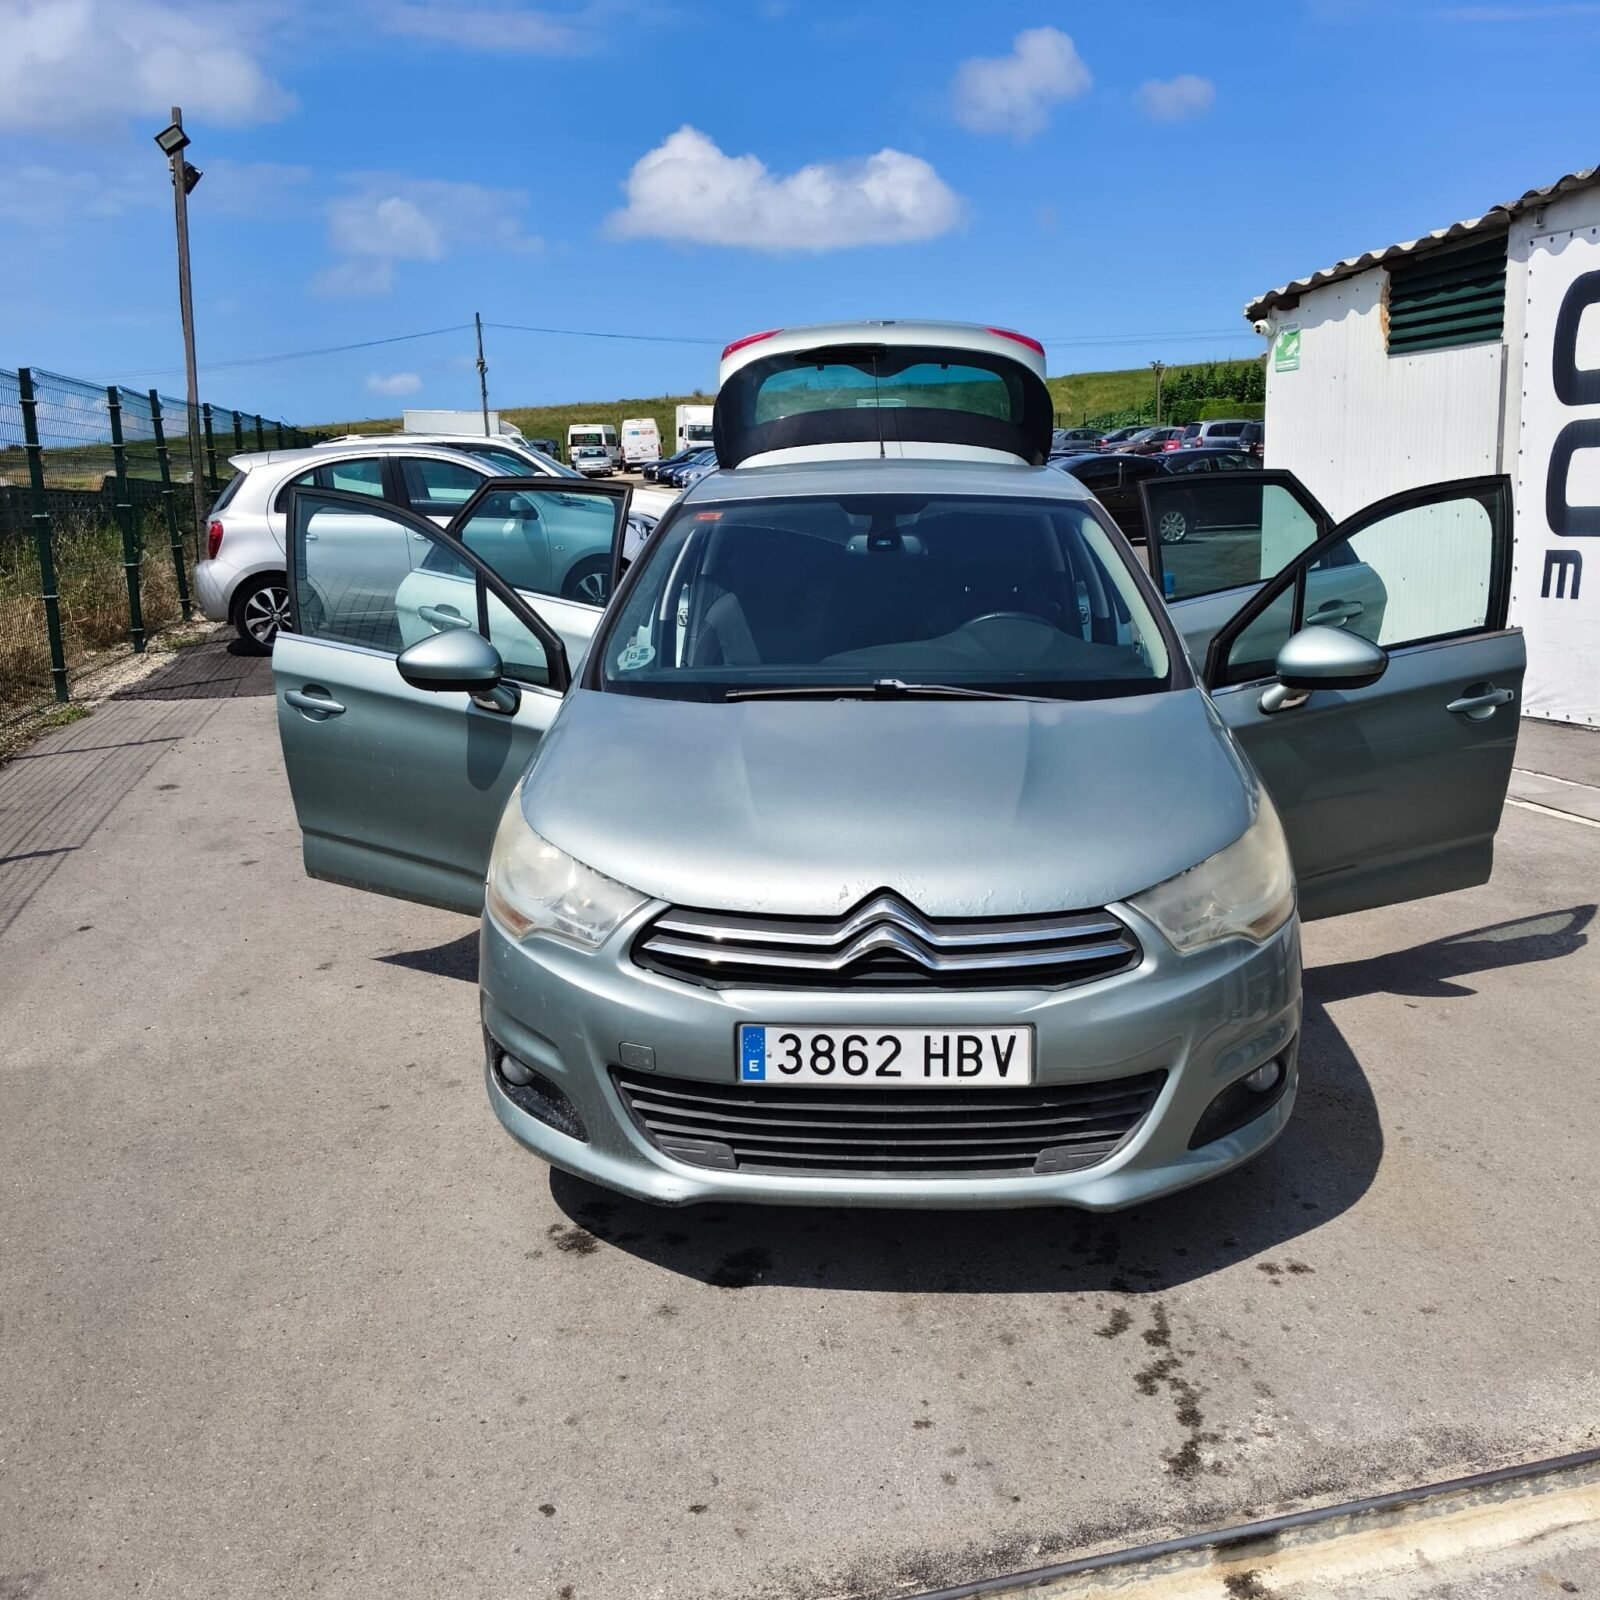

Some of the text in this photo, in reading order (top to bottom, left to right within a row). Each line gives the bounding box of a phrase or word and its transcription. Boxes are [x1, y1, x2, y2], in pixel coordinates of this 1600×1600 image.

[749, 1060, 759, 1071] E
[777, 1033, 1016, 1077] 3862 HBV
